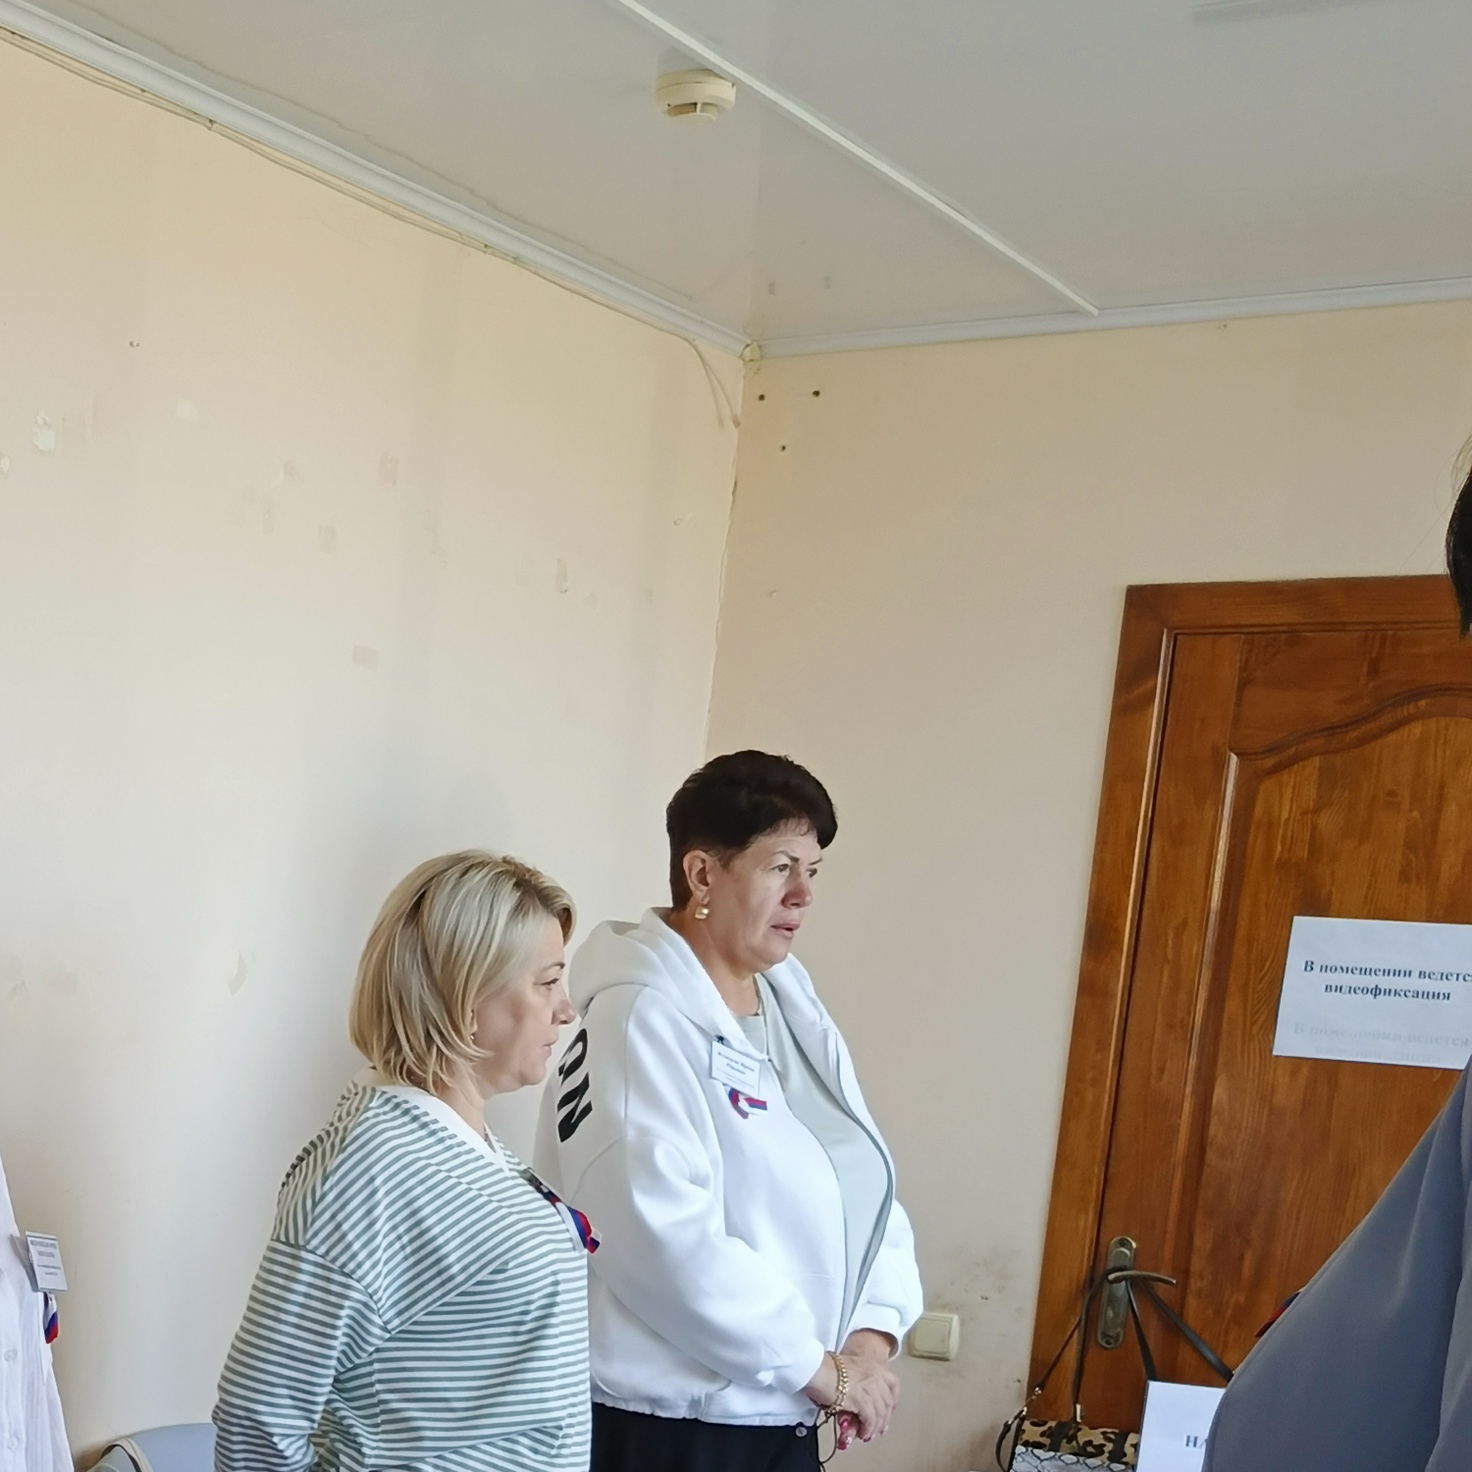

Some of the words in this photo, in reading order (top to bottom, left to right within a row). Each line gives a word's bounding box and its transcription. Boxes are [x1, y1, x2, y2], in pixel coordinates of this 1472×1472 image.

[1303, 960, 1314, 972] В
[1319, 964, 1412, 979] помещении
[1418, 969, 1472, 983] ведетс
[1324, 984, 1451, 1001] видеофиксация
